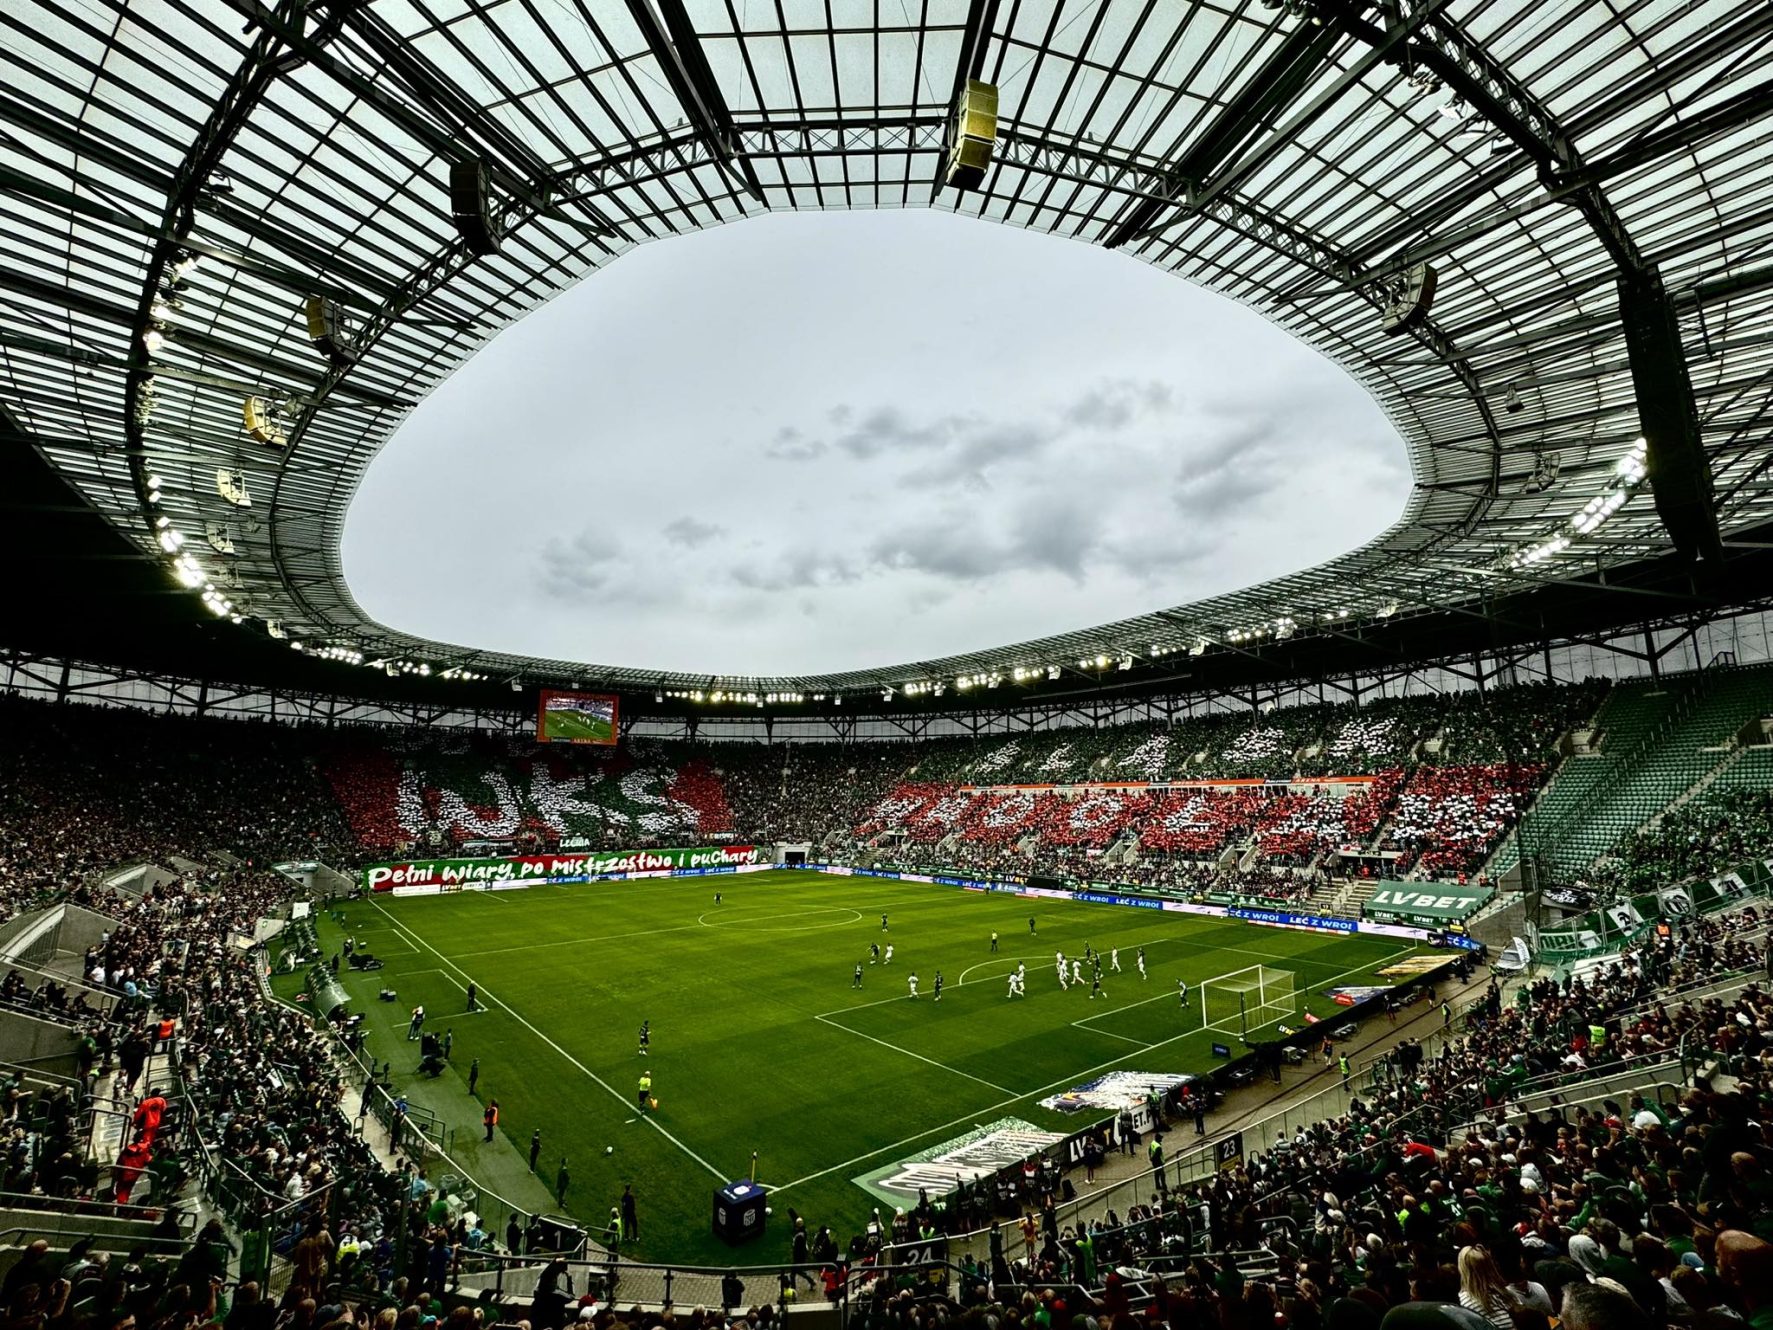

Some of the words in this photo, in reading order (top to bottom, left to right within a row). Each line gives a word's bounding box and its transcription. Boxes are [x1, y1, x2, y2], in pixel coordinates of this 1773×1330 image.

[367, 864, 435, 891] Pełni
[520, 861, 544, 879] po
[551, 852, 672, 876] mistrzostwo
[679, 855, 685, 867] i
[1373, 890, 1478, 910] LVBET
[1243, 911, 1250, 919] Z
[1252, 913, 1280, 922] WRO!
[1289, 915, 1309, 925] LEĆ
[1321, 920, 1353, 930] WRO!
[1223, 1139, 1236, 1159] 23
[907, 1246, 934, 1265] 24
